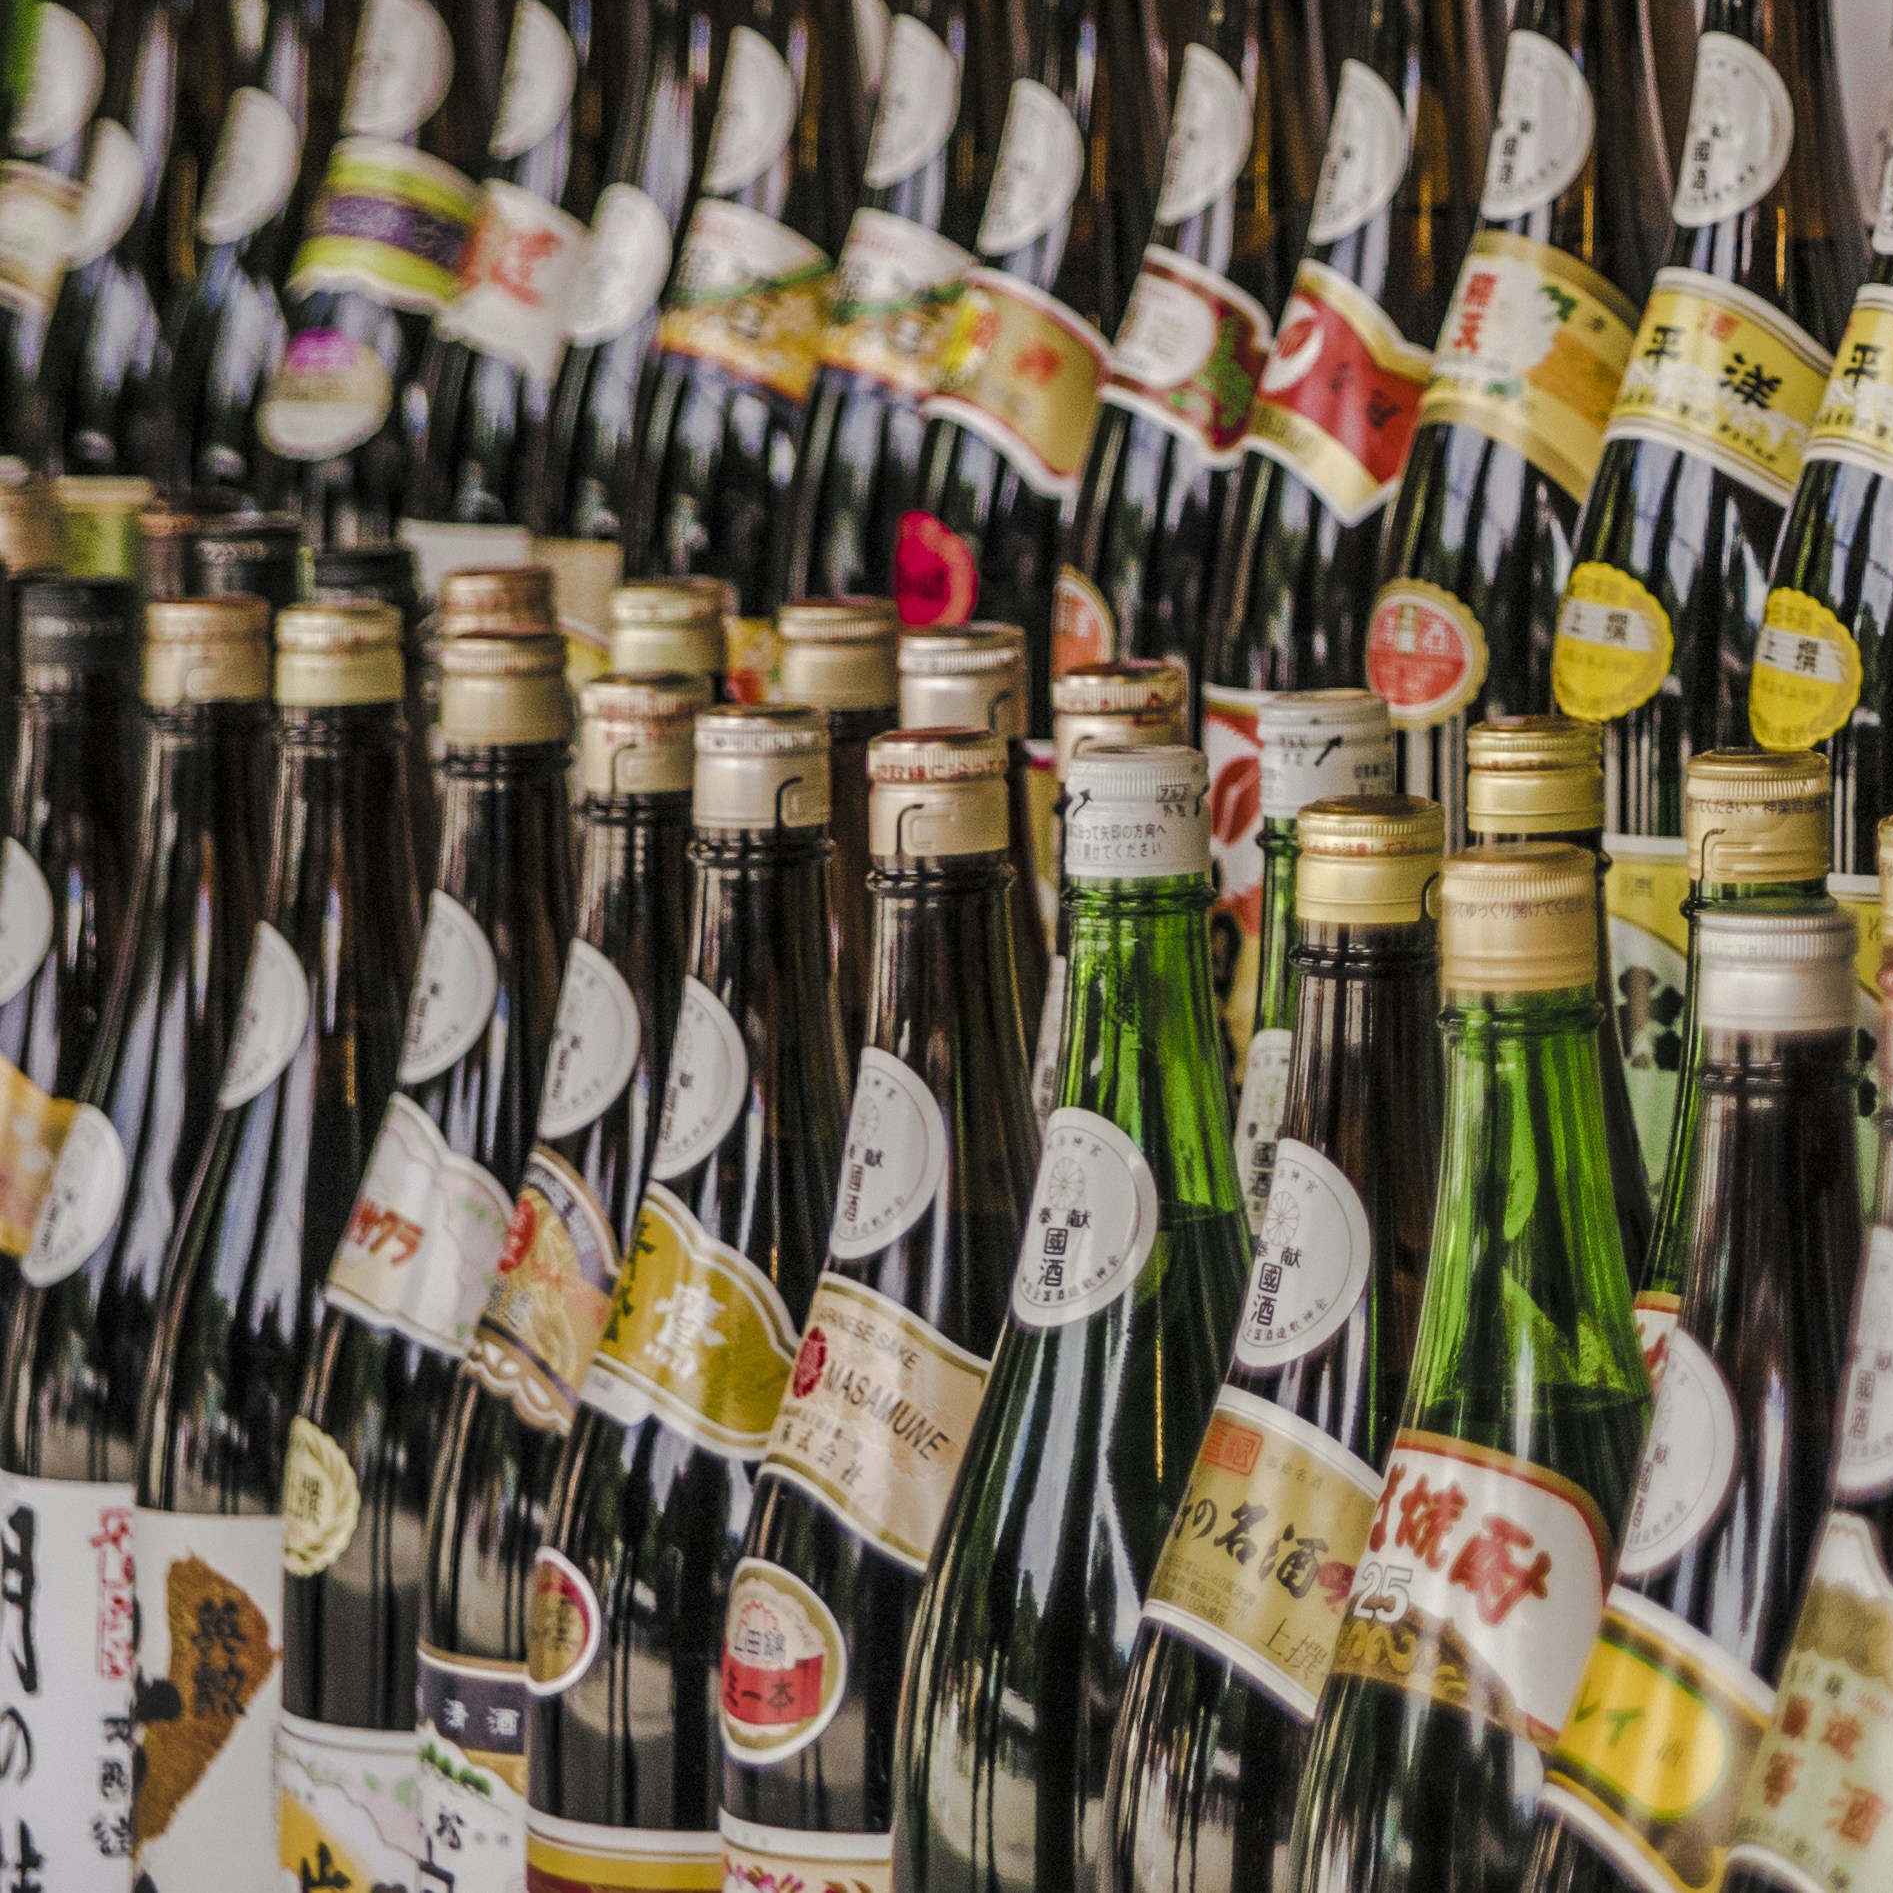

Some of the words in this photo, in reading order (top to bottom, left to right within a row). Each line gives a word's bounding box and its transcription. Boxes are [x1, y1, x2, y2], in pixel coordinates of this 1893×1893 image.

[1038, 1227, 1069, 1287] 國酒
[1251, 1262, 1282, 1326] 國酒
[1353, 1561, 1415, 1625] 25
